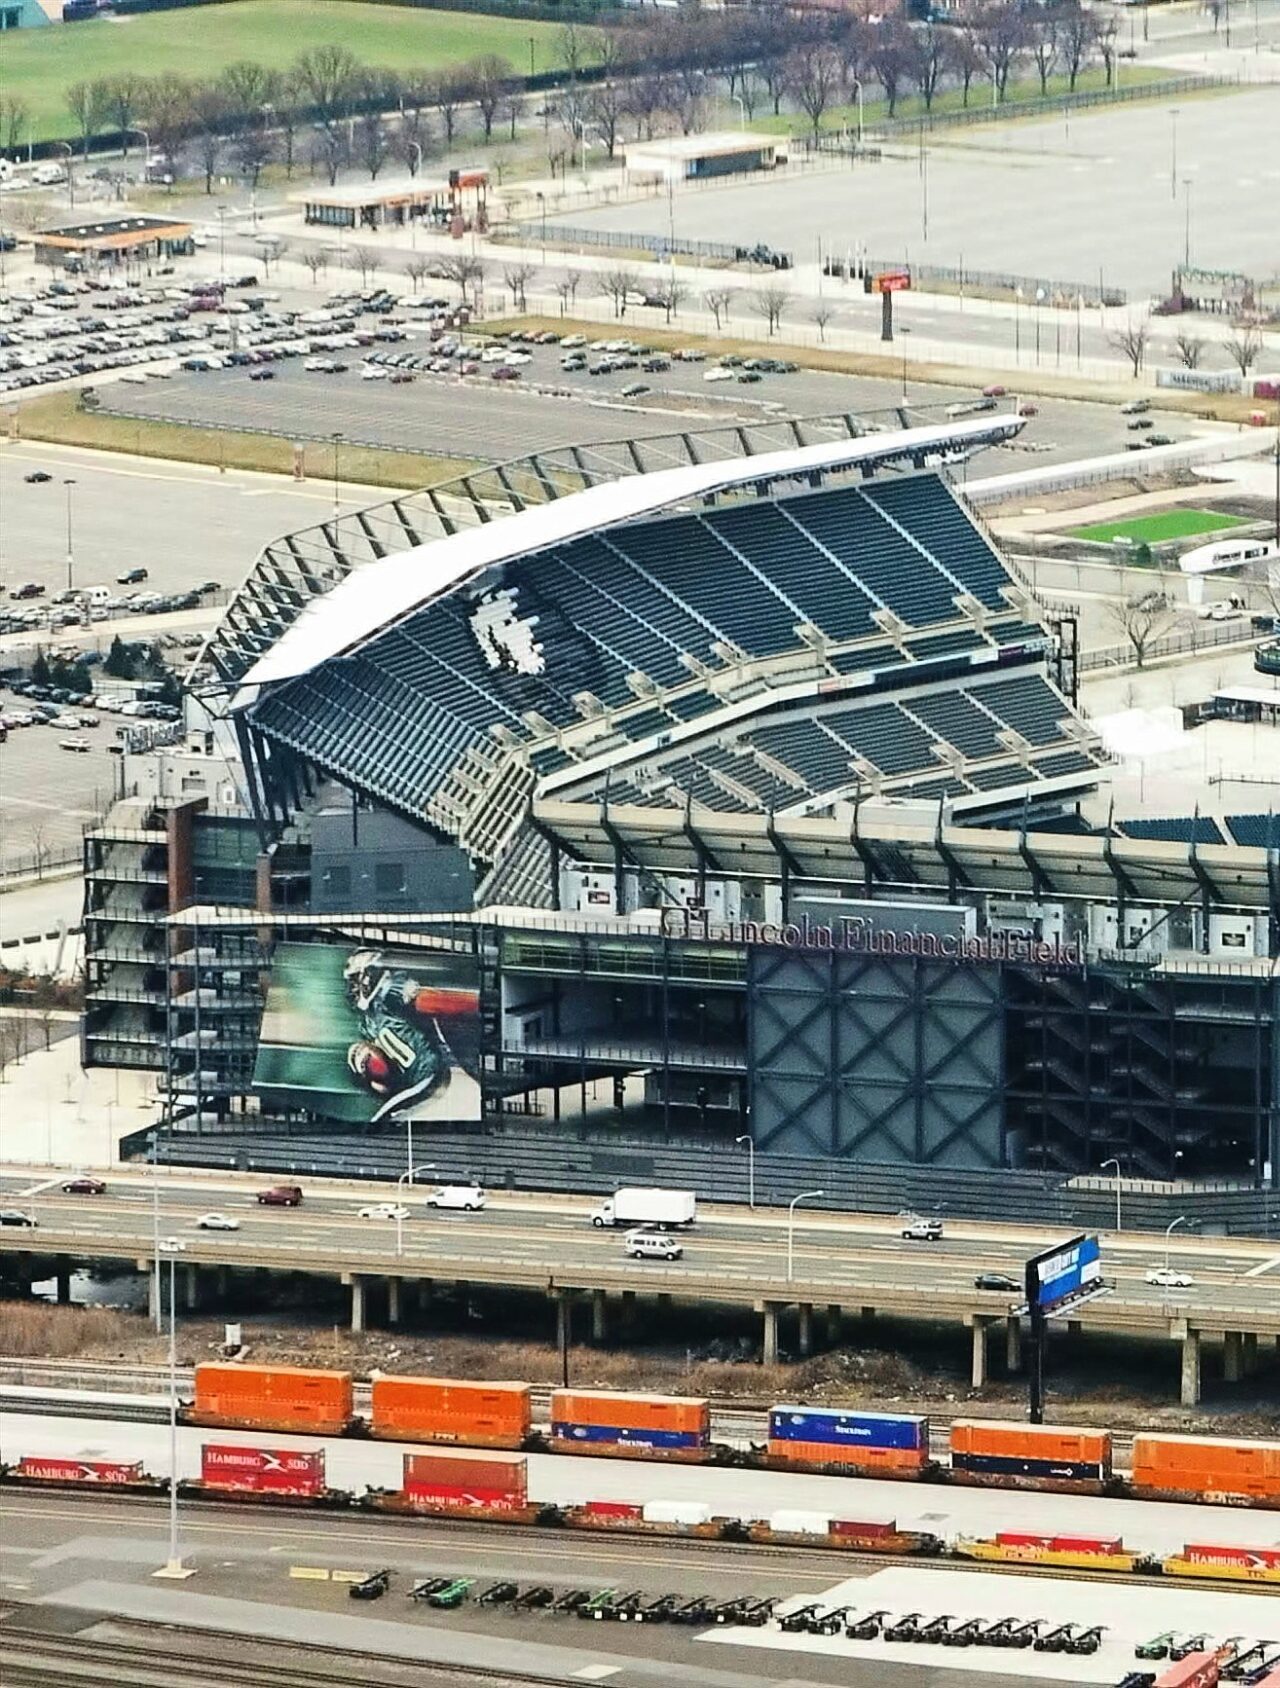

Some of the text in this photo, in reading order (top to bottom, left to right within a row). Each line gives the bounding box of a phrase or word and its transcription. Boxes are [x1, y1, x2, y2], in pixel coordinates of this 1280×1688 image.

[702, 907, 1085, 966] Lincoln Financial Field
[207, 1452, 261, 1467] HAMBURG
[25, 1465, 79, 1480] HAMBURG
[1190, 1552, 1246, 1568] HAMBURG
